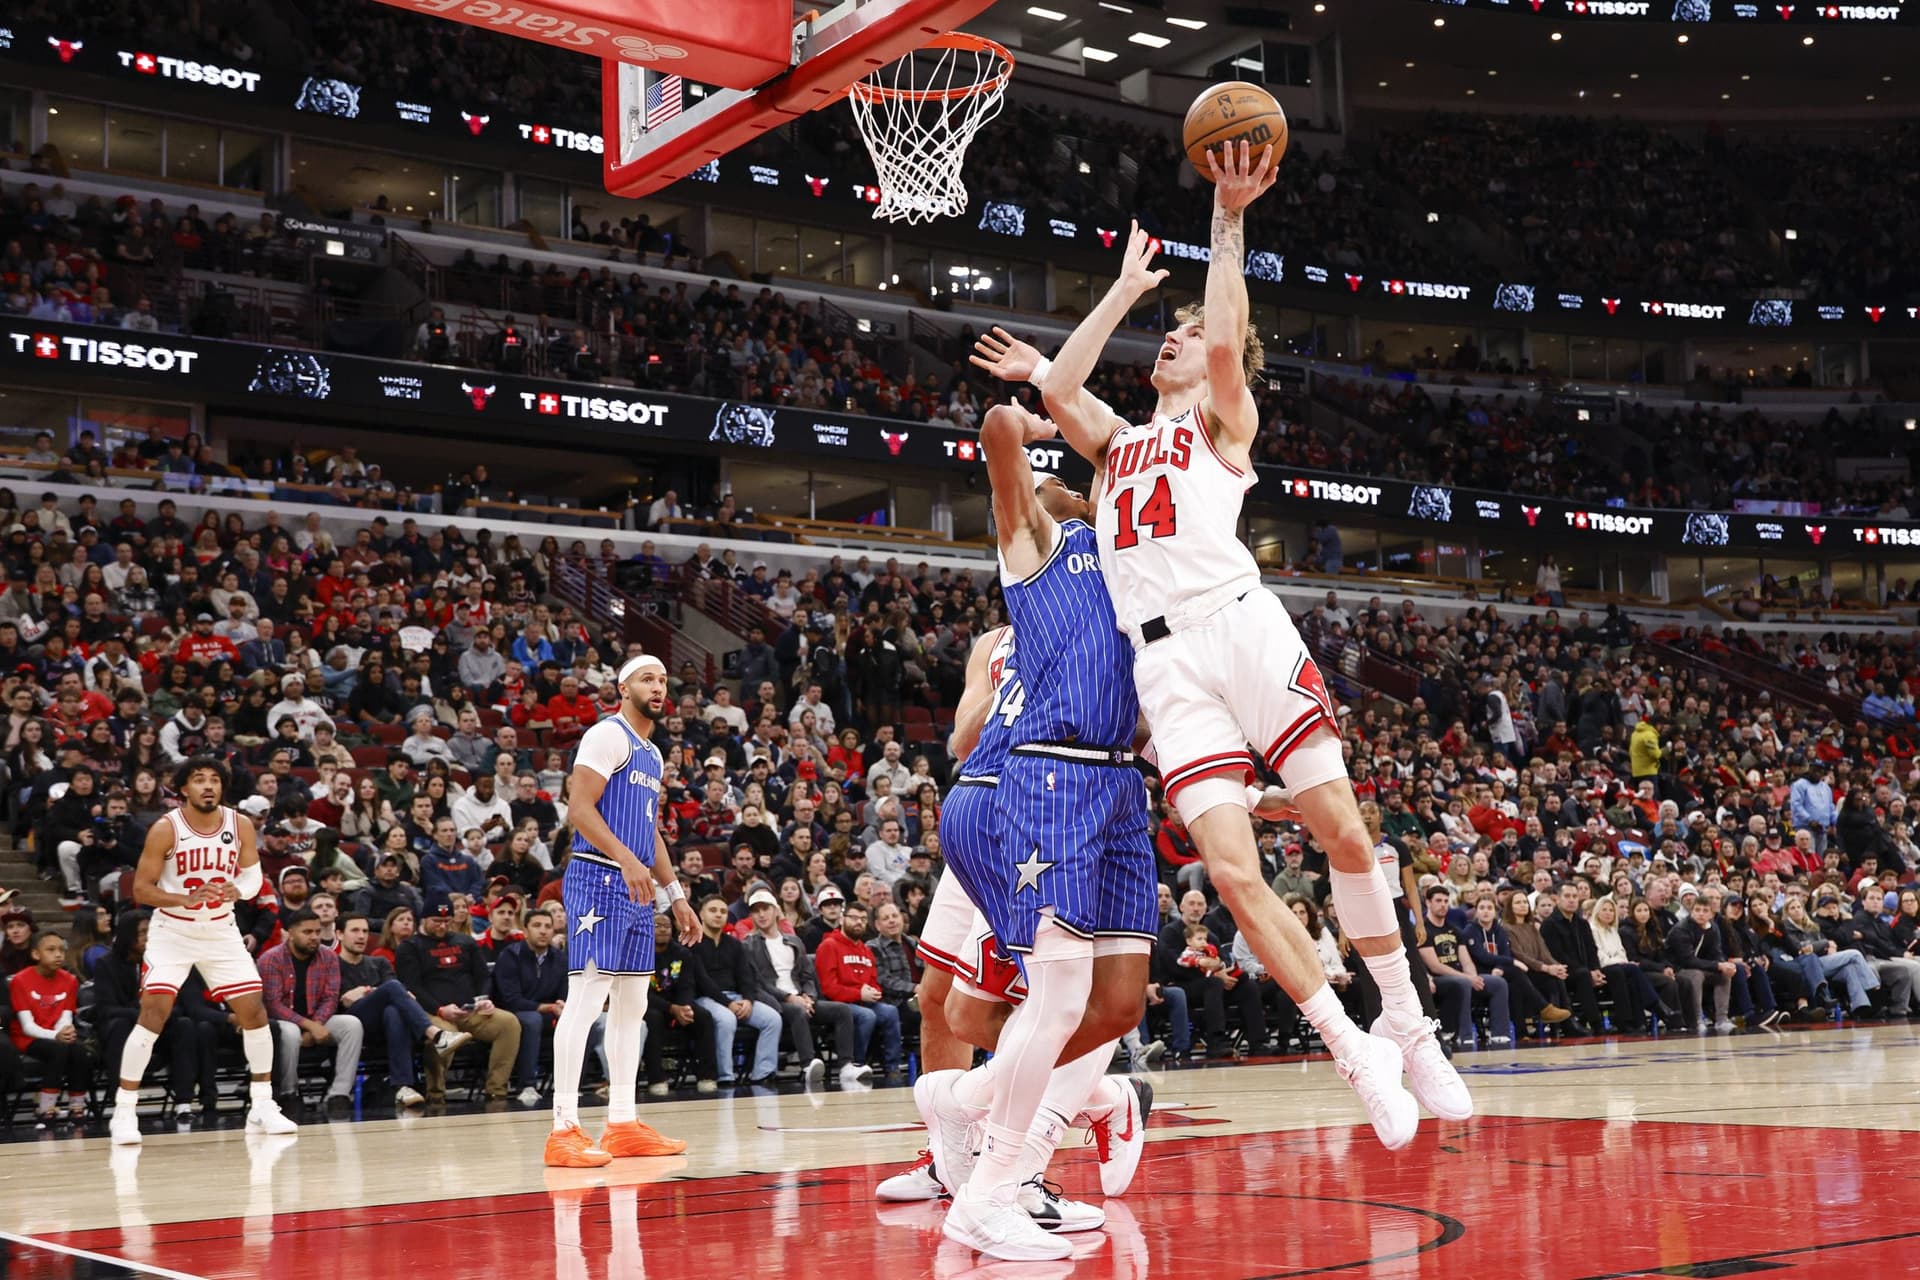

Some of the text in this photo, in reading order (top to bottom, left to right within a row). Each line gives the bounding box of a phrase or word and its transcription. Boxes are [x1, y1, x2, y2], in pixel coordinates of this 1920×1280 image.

[1587, 2, 1650, 16] TISSOT
[1840, 5, 1900, 20] TISSOT
[157, 57, 261, 92] TISSOT
[552, 128, 604, 153] TISS
[1161, 240, 1212, 262] TISSO
[1405, 283, 1471, 300] TISSOT
[1663, 303, 1726, 320] TISSOT
[62, 337, 199, 374] TISSOT
[561, 395, 669, 426] TISSOT
[1106, 426, 1194, 497] BULLS
[1309, 480, 1382, 506] TISSOT
[1114, 474, 1176, 551] 14
[1588, 513, 1654, 535] TISSOT
[646, 798, 654, 823] 4
[175, 847, 237, 877] BULLS
